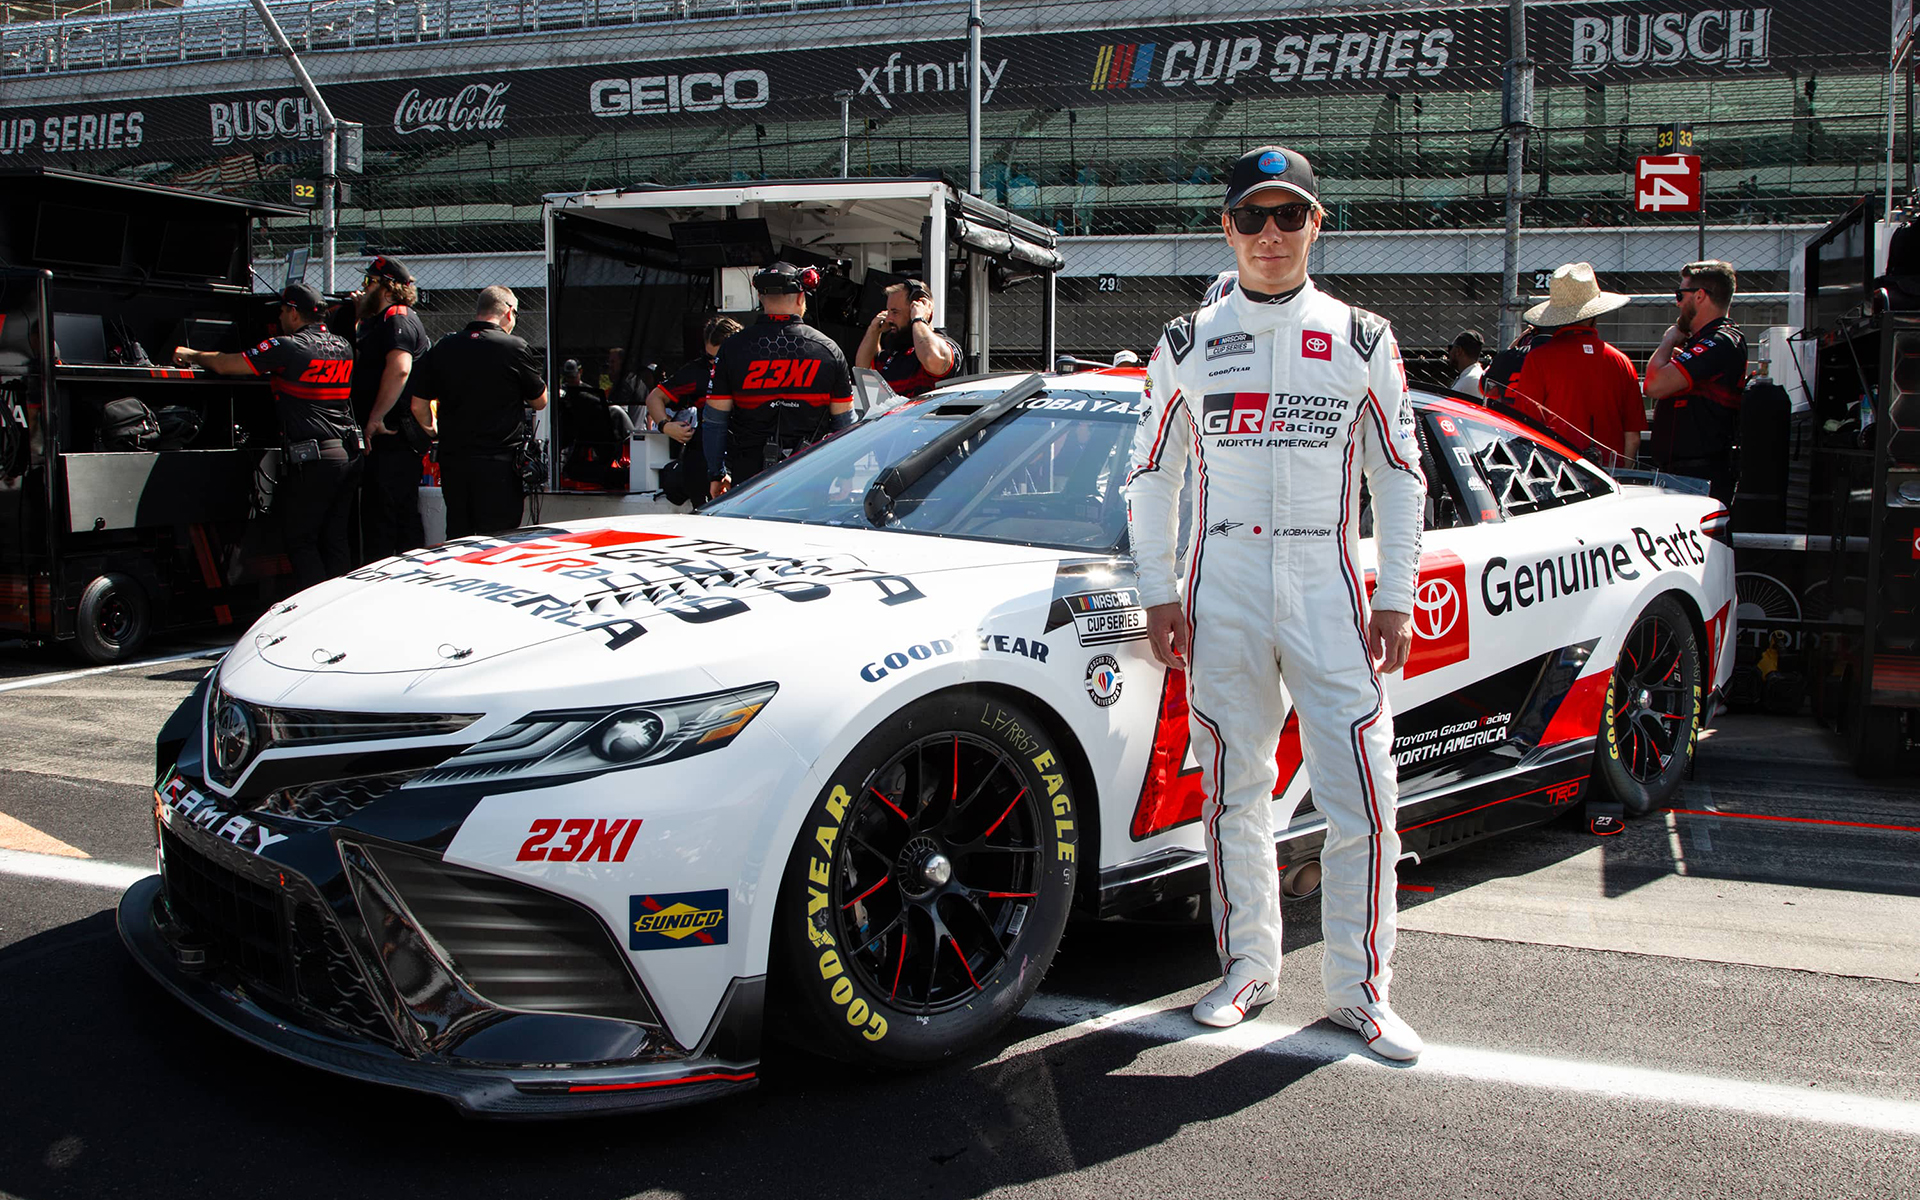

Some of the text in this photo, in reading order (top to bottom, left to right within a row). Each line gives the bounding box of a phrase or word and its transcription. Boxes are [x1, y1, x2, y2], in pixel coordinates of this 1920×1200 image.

[1569, 7, 1773, 74] BUSCH
[1161, 28, 1454, 88] CUP SERIES
[856, 51, 1008, 109] xfinity
[590, 69, 769, 117] GEICO
[43, 111, 145, 153] SERIES
[209, 97, 323, 146] BUSCH
[1658, 130, 1673, 149] 33
[1679, 129, 1693, 148] 33
[295, 184, 315, 198] 32
[1639, 157, 1690, 212] 14
[1213, 342, 1247, 355] CUP SERIES
[1222, 334, 1247, 345] NASCAR
[299, 359, 353, 383] 23XI
[742, 359, 821, 389] 23XI
[1208, 366, 1251, 377] GOODYEAR
[1275, 393, 1349, 410] TOYOTA
[1203, 408, 1263, 434] GR
[1272, 407, 1342, 422] GAZOO
[1269, 420, 1338, 439] Racing
[1216, 438, 1329, 448] NORTH AMERICA
[1273, 528, 1281, 536] K.
[1480, 537, 1640, 617] Genuine
[1631, 523, 1705, 571] Parts
[1091, 592, 1132, 609] NASCAR
[432, 577, 649, 651] AMERICA
[1087, 612, 1139, 632] CUP SERIES
[981, 703, 1039, 756] LF/RR67
[1395, 712, 1511, 748] TOYOTA GAZOO Racing
[1686, 685, 1701, 759] EAGLE
[1391, 726, 1507, 767] NORTH AMERICA
[1032, 749, 1075, 863] EAGLE
[1546, 782, 1579, 806] TRD
[1595, 816, 1612, 826] 23
[515, 818, 643, 862] 23XI
[637, 911, 721, 932] SUNOCO
